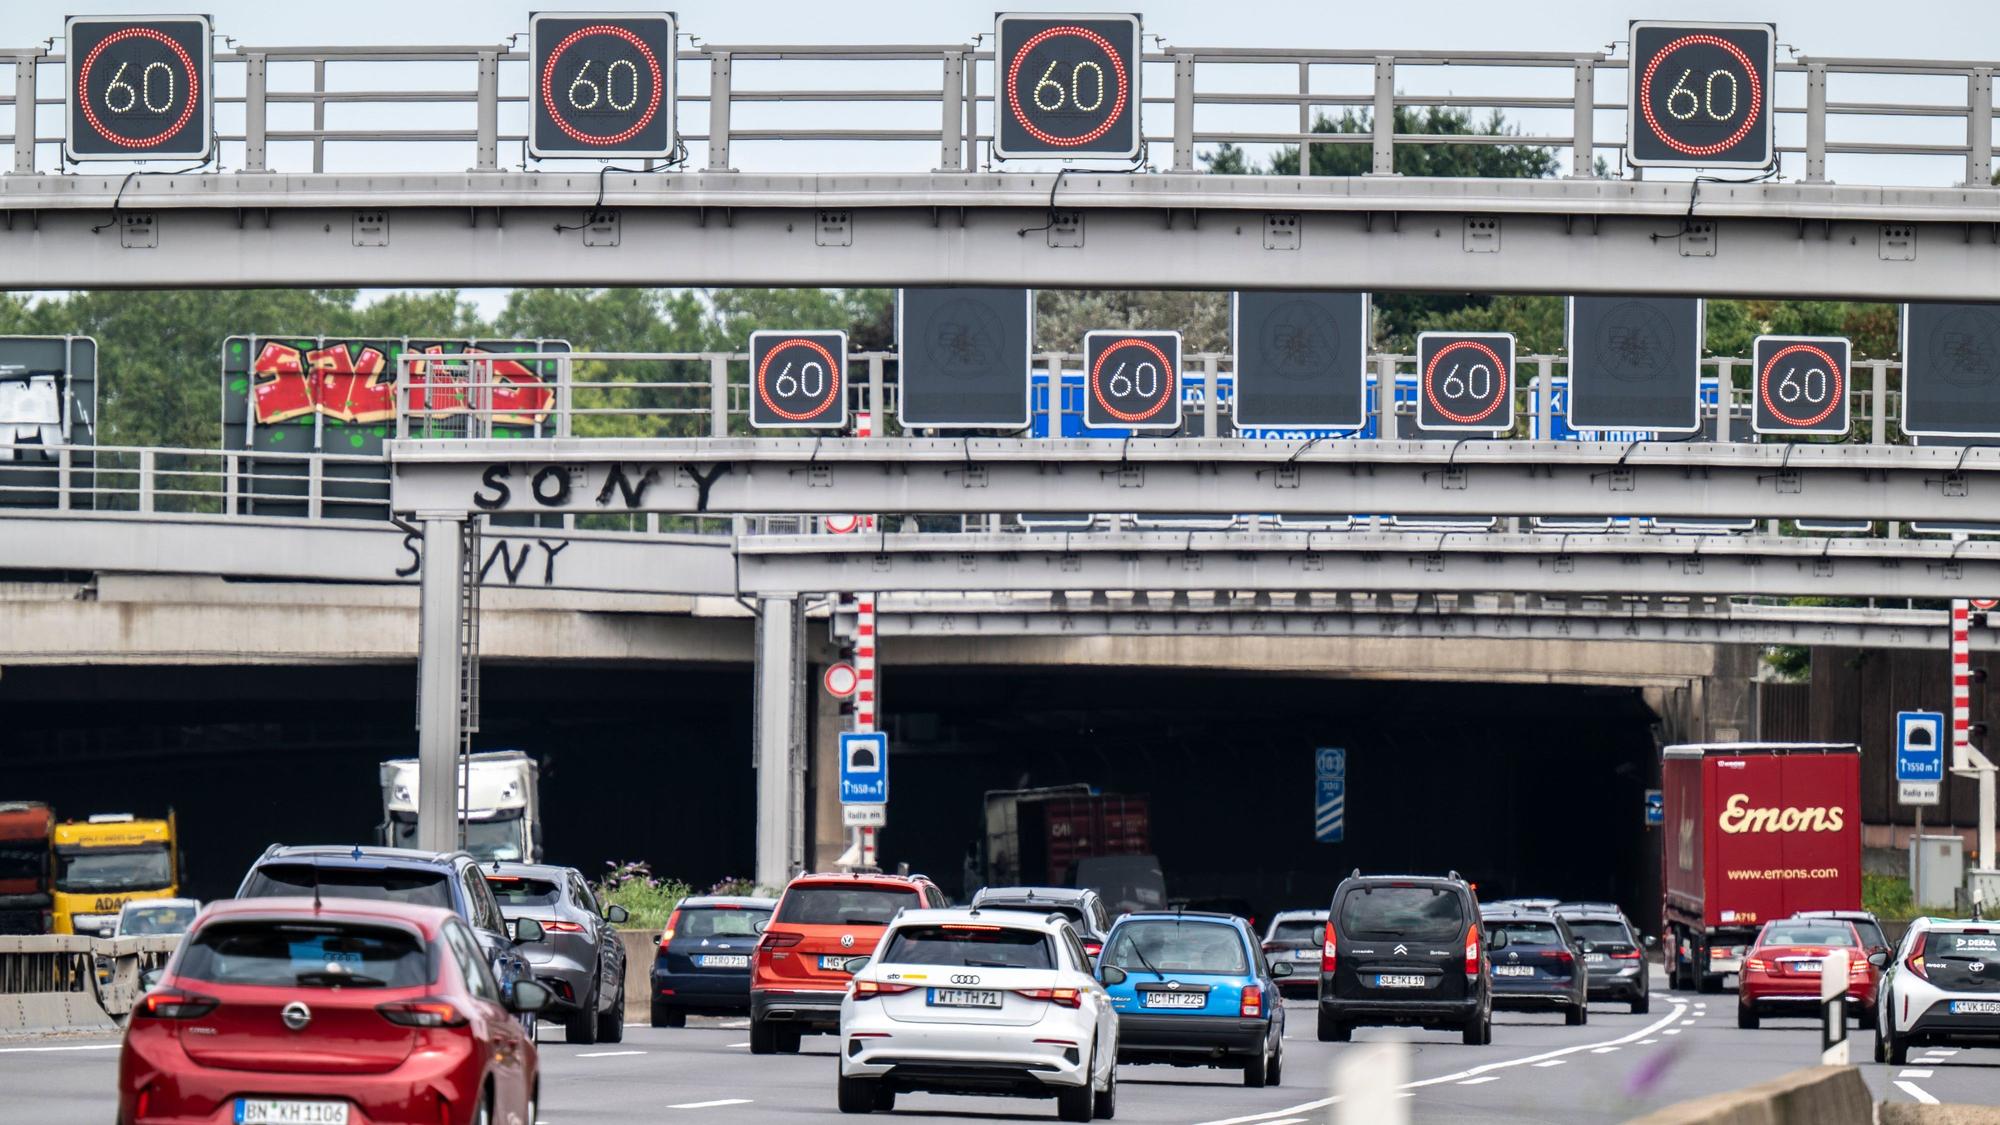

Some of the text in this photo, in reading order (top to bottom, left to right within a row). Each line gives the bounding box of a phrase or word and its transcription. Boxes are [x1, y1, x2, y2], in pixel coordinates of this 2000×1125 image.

[104, 62, 173, 112] 60
[568, 59, 638, 111] 60
[1033, 60, 1105, 111] 60
[1666, 68, 1737, 121] 60
[775, 362, 823, 397] 60
[1109, 362, 1157, 397] 60
[1443, 364, 1490, 399] 60
[1778, 366, 1827, 404] 60
[473, 463, 732, 511] SONY
[395, 534, 569, 585] SNY
[1907, 762, 1924, 771] 1550
[1719, 793, 1844, 834] Emons
[1727, 868, 1838, 880] www.emons.com
[827, 958, 839, 967] MG
[938, 990, 997, 1004] WT TH 71
[1381, 976, 1424, 985] SLE KI 19
[1148, 993, 1204, 1005] AC HT 225
[1967, 1002, 1978, 1010] VK
[246, 1104, 343, 1122] BN KH 1106
